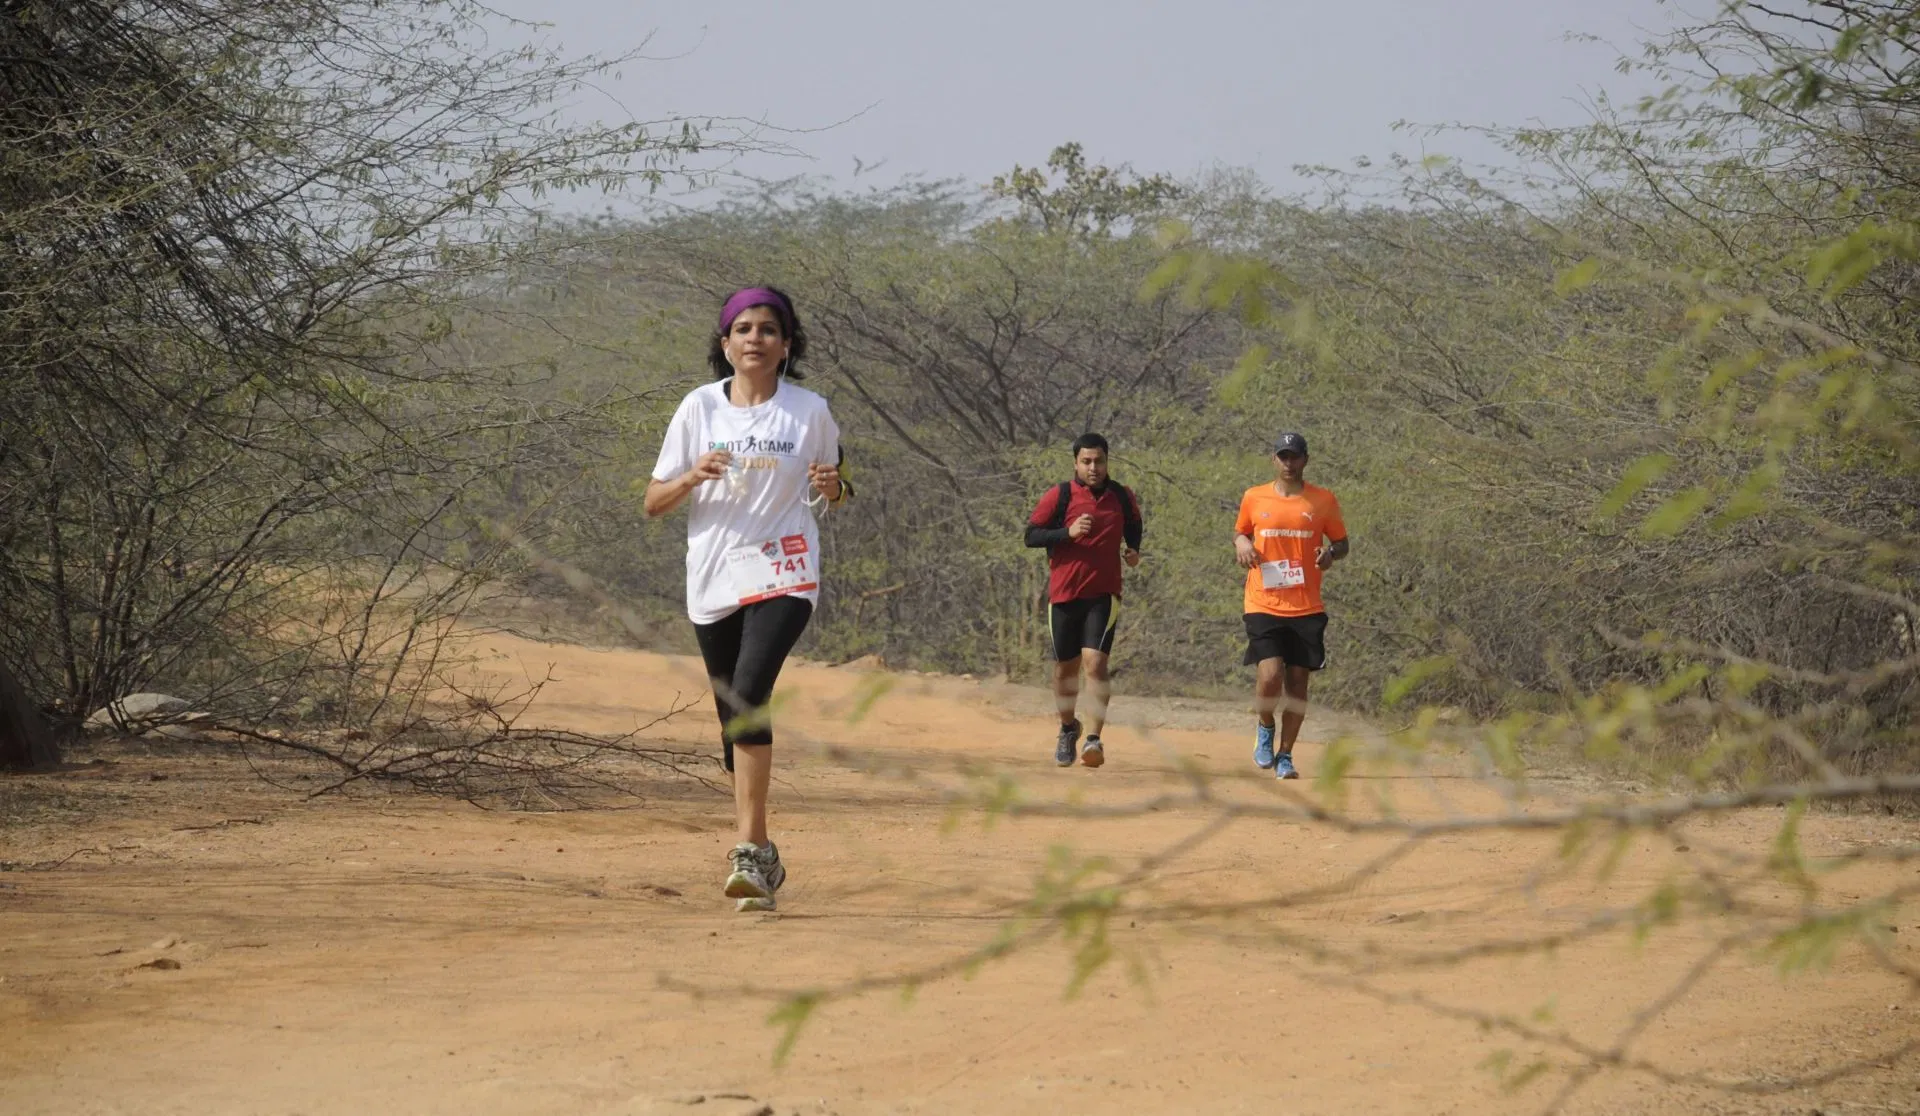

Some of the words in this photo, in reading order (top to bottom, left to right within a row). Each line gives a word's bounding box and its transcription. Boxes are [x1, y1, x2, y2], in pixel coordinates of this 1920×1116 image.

[708, 440, 743, 452] BOT
[759, 440, 794, 454] CAMP
[771, 556, 806, 576] 741
[1282, 569, 1301, 579] 704
